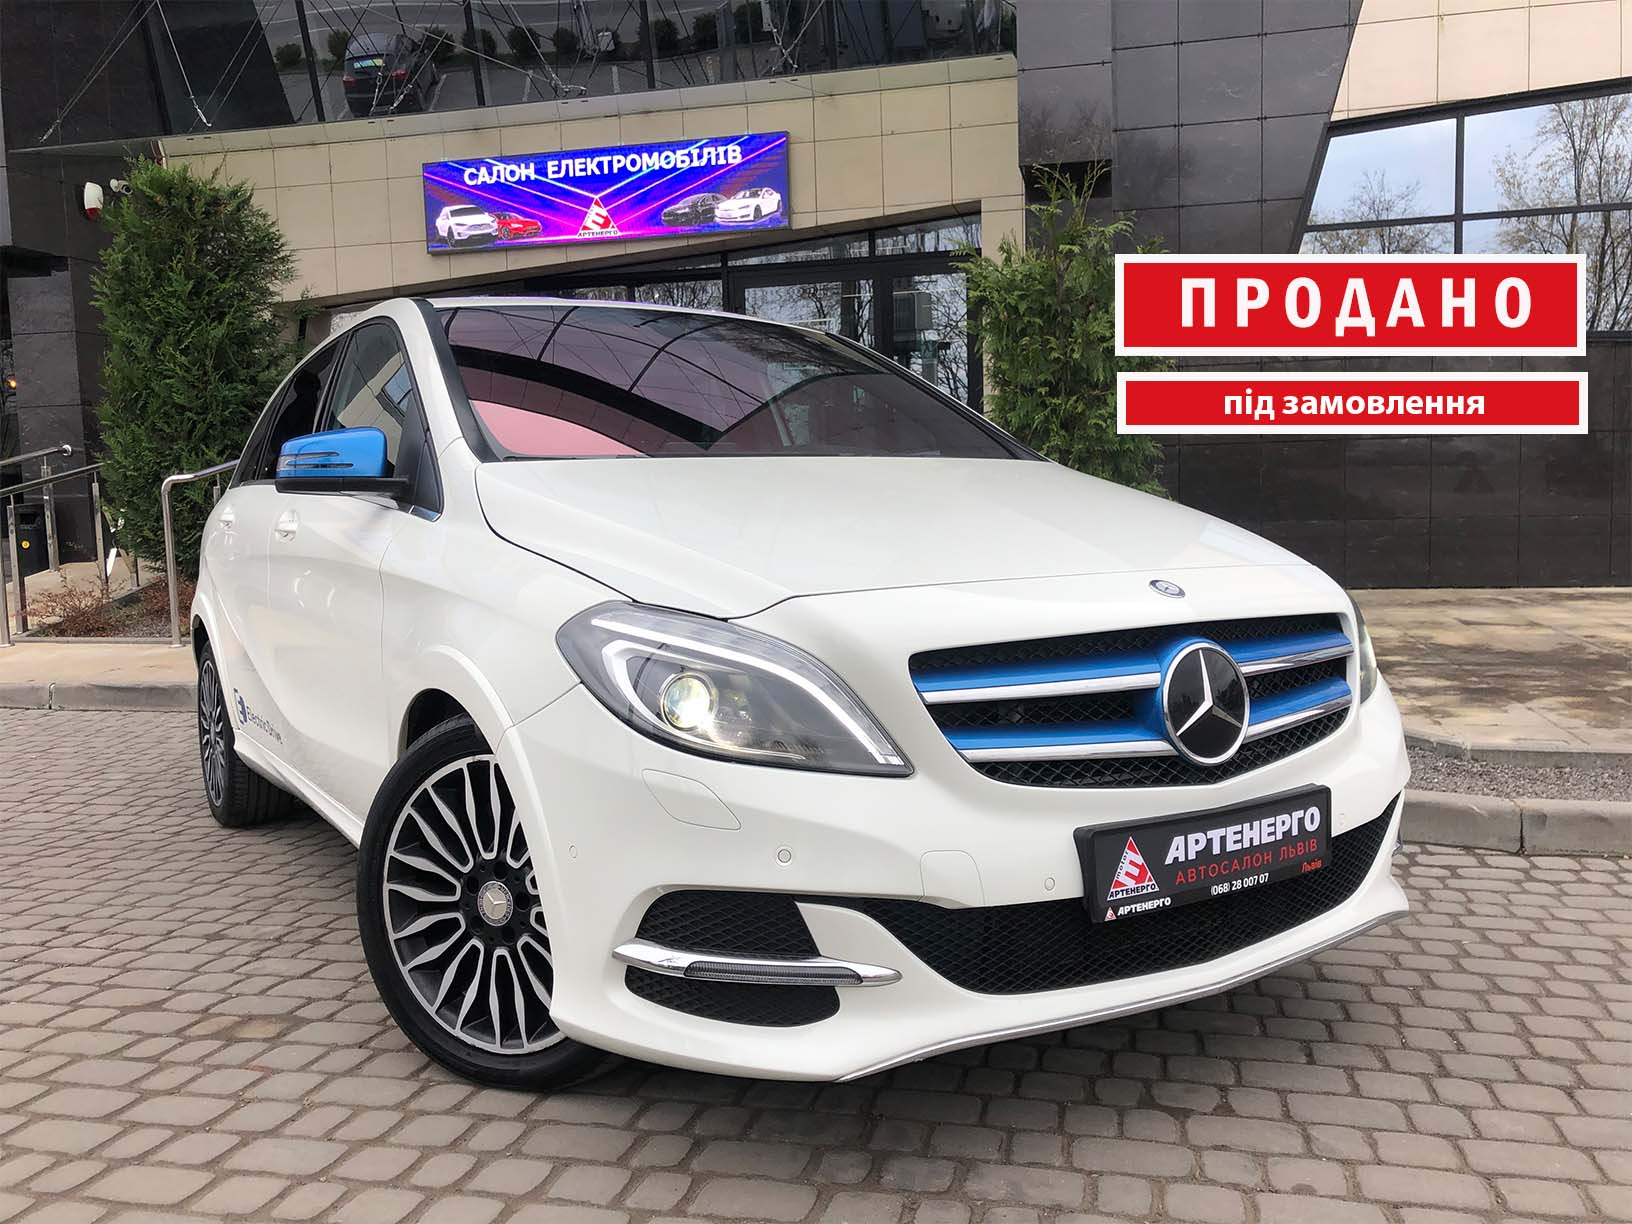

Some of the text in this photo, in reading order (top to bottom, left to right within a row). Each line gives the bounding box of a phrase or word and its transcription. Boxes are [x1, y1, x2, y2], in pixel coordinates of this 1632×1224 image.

[463, 145, 742, 186] САЛОН ЕЛЕКТРОМОБІЛІВ
[577, 229, 619, 238] АРТЕНЕРГО
[1164, 807, 1320, 864] АРТЕНЕРГО
[1175, 838, 1318, 885] АВТОСАЛОН ЛЬВІВ
[1301, 858, 1322, 874] Львів
[1108, 883, 1157, 900] АРТЕНЕРГО
[1210, 881, 1230, 896] (068)
[1231, 878, 1242, 891] 28
[1117, 897, 1171, 916] АРТЕНЕРГО
